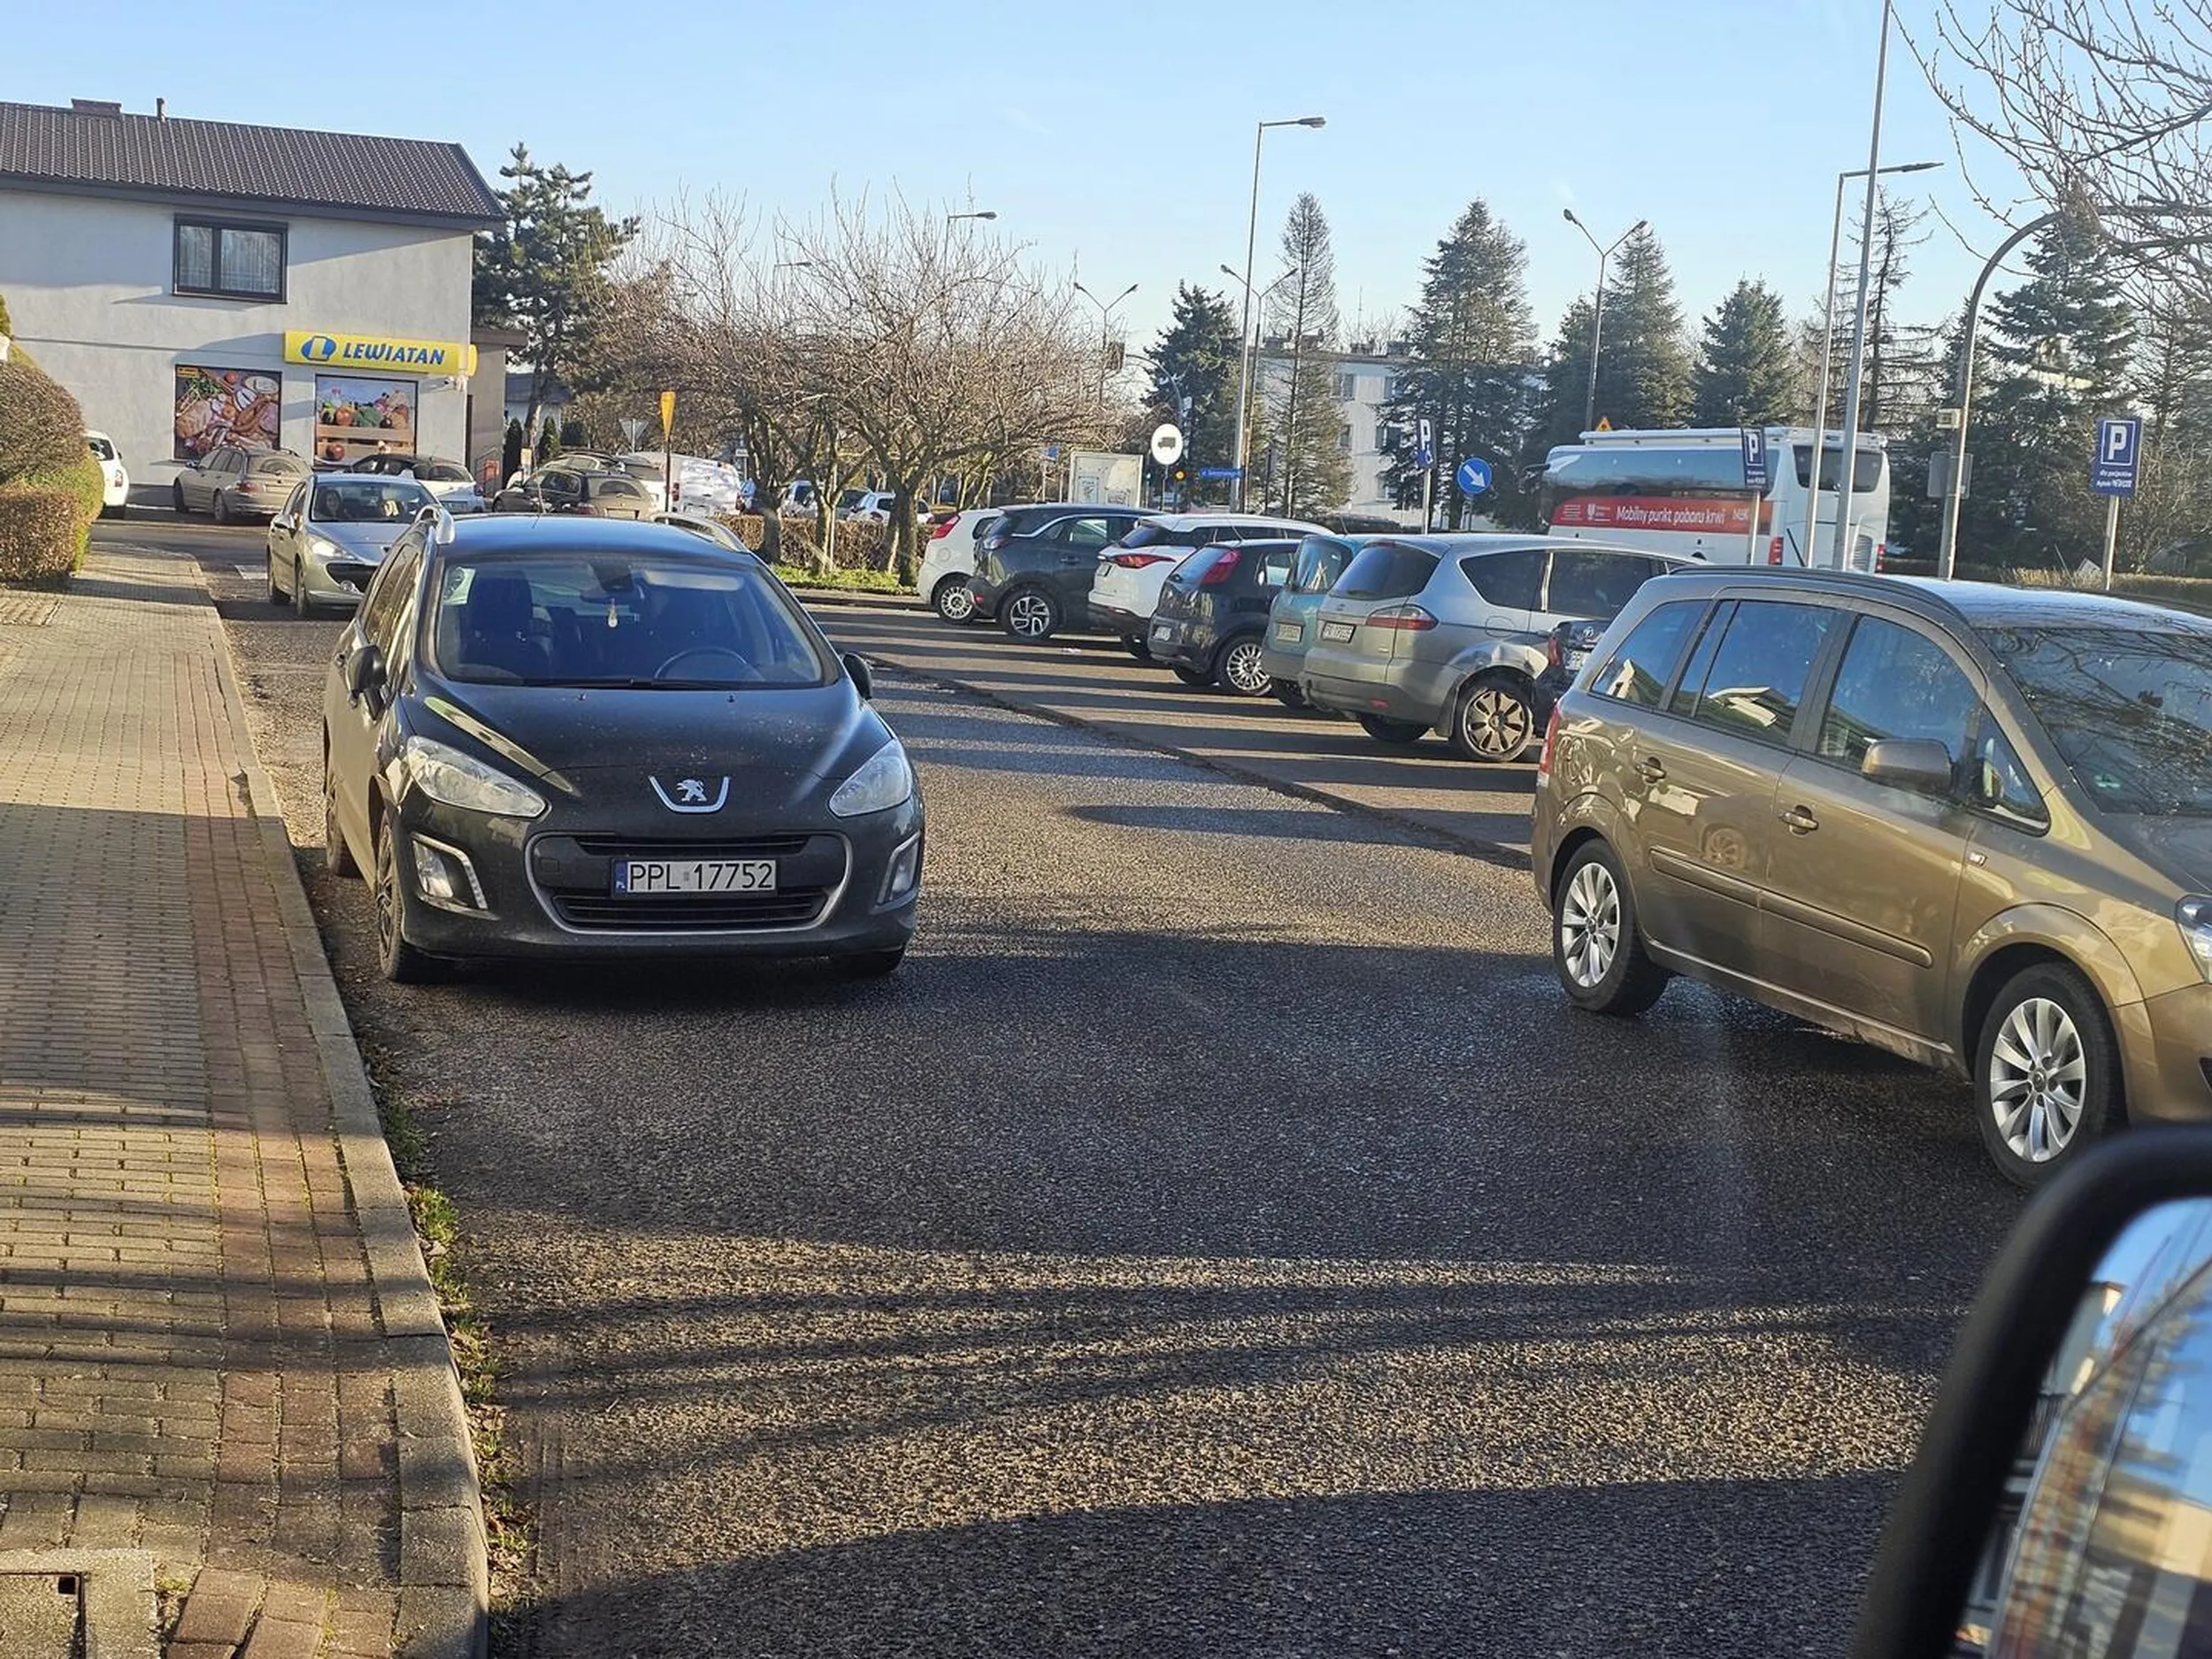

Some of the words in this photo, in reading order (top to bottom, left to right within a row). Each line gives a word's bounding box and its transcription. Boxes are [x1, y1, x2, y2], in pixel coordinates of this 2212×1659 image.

[342, 342, 445, 365] LEWIATAN
[1420, 419, 1431, 451] P
[1747, 433, 1759, 462] P
[2108, 425, 2127, 460] P
[1617, 505, 1647, 525] Mobilny
[1647, 507, 1672, 525] punkt
[630, 864, 680, 890] PPL
[694, 863, 772, 890] 17752
